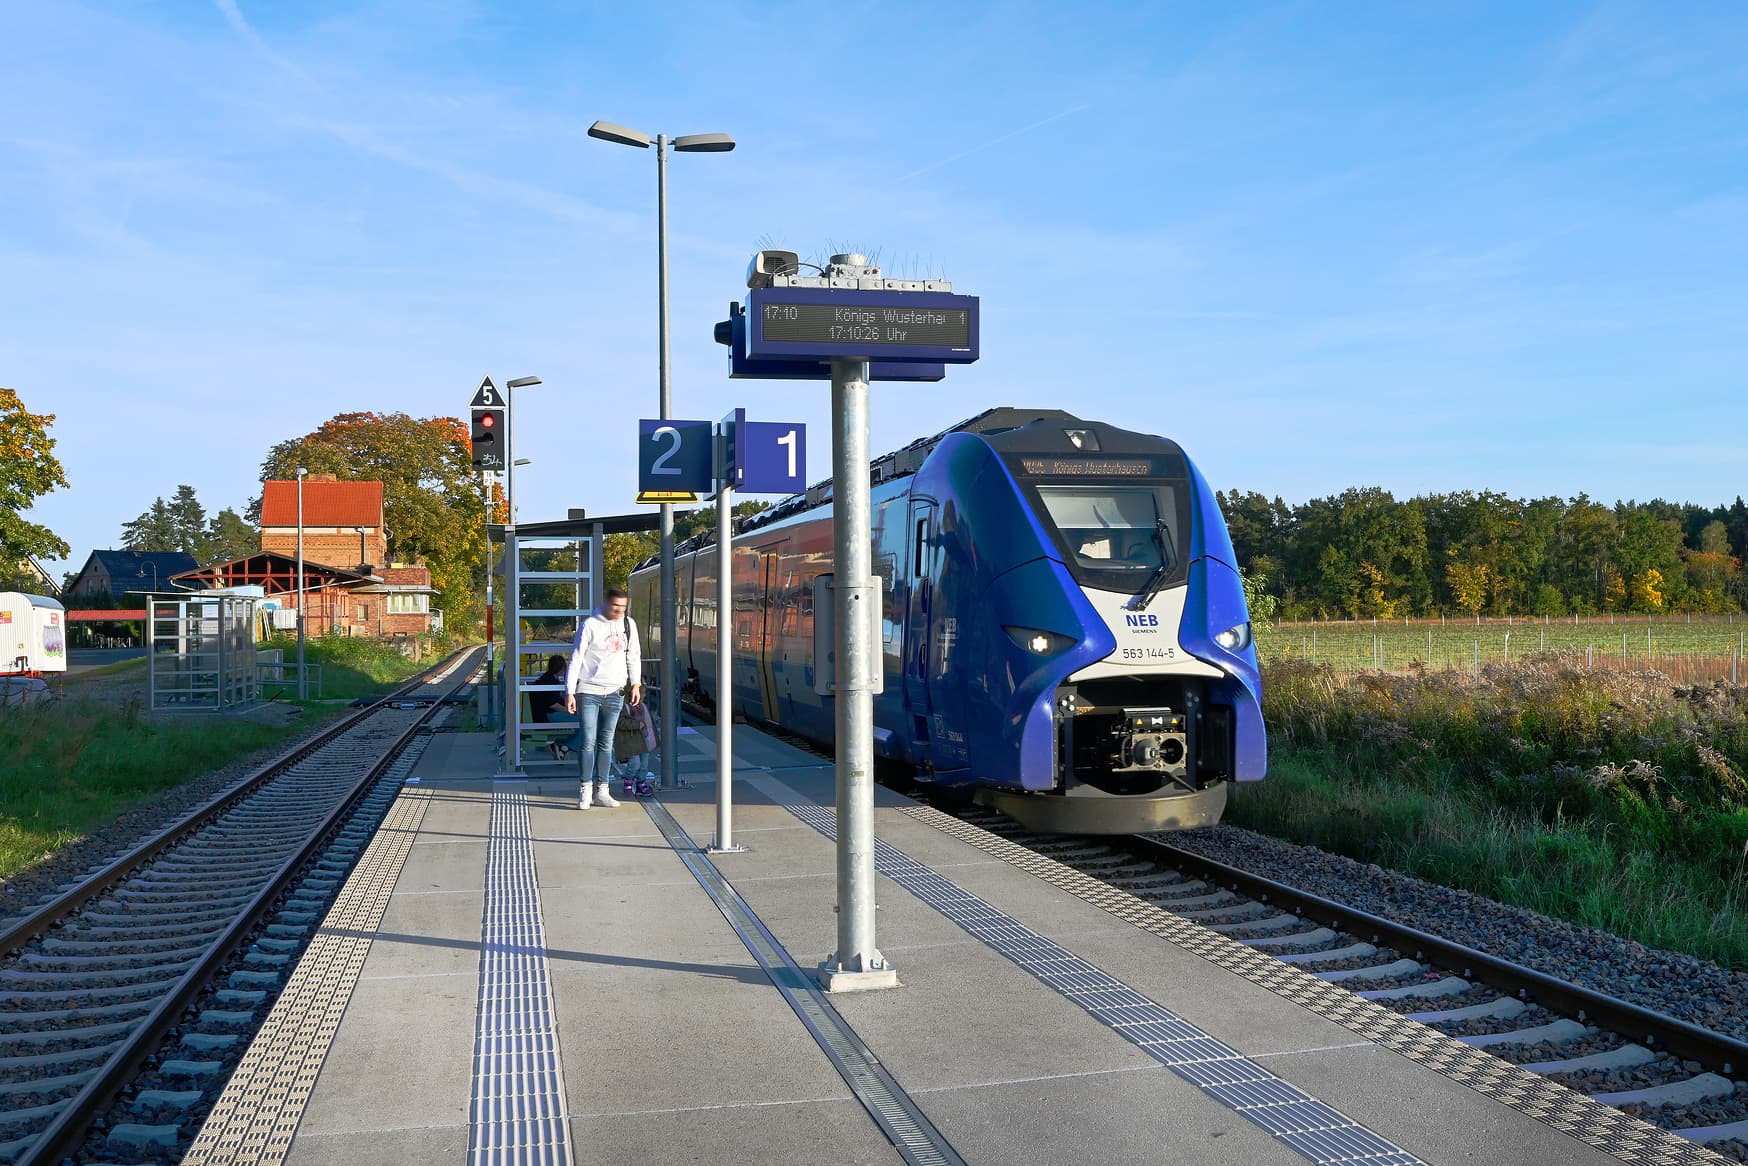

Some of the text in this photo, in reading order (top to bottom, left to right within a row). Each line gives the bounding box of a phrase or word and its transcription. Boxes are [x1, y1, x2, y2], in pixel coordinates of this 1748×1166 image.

[764, 306, 798, 320] 17:10
[835, 308, 876, 325] Königs
[959, 312, 966, 325] 1
[887, 327, 908, 341] Uhr
[482, 385, 493, 405] 5
[651, 426, 682, 475] 2
[777, 430, 797, 477] 1
[1125, 614, 1159, 627] NEB
[1122, 647, 1175, 659] 563 144-5
